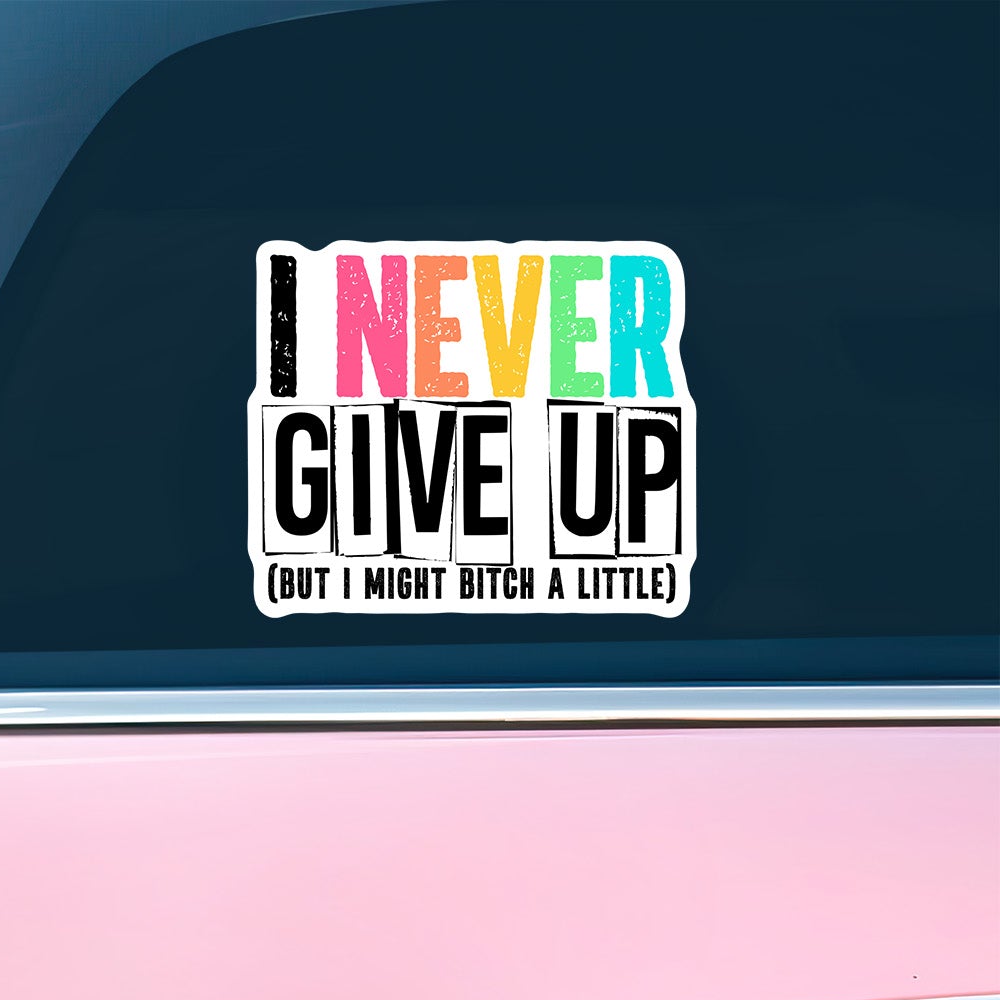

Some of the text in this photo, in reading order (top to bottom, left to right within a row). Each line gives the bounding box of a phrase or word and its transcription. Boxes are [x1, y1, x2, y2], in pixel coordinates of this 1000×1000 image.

[270, 255, 674, 398] I NEVER
[275, 410, 679, 543] GIVE UP
[267, 563, 677, 604] (BUT I MIGHT BITCH A LITTLE)
